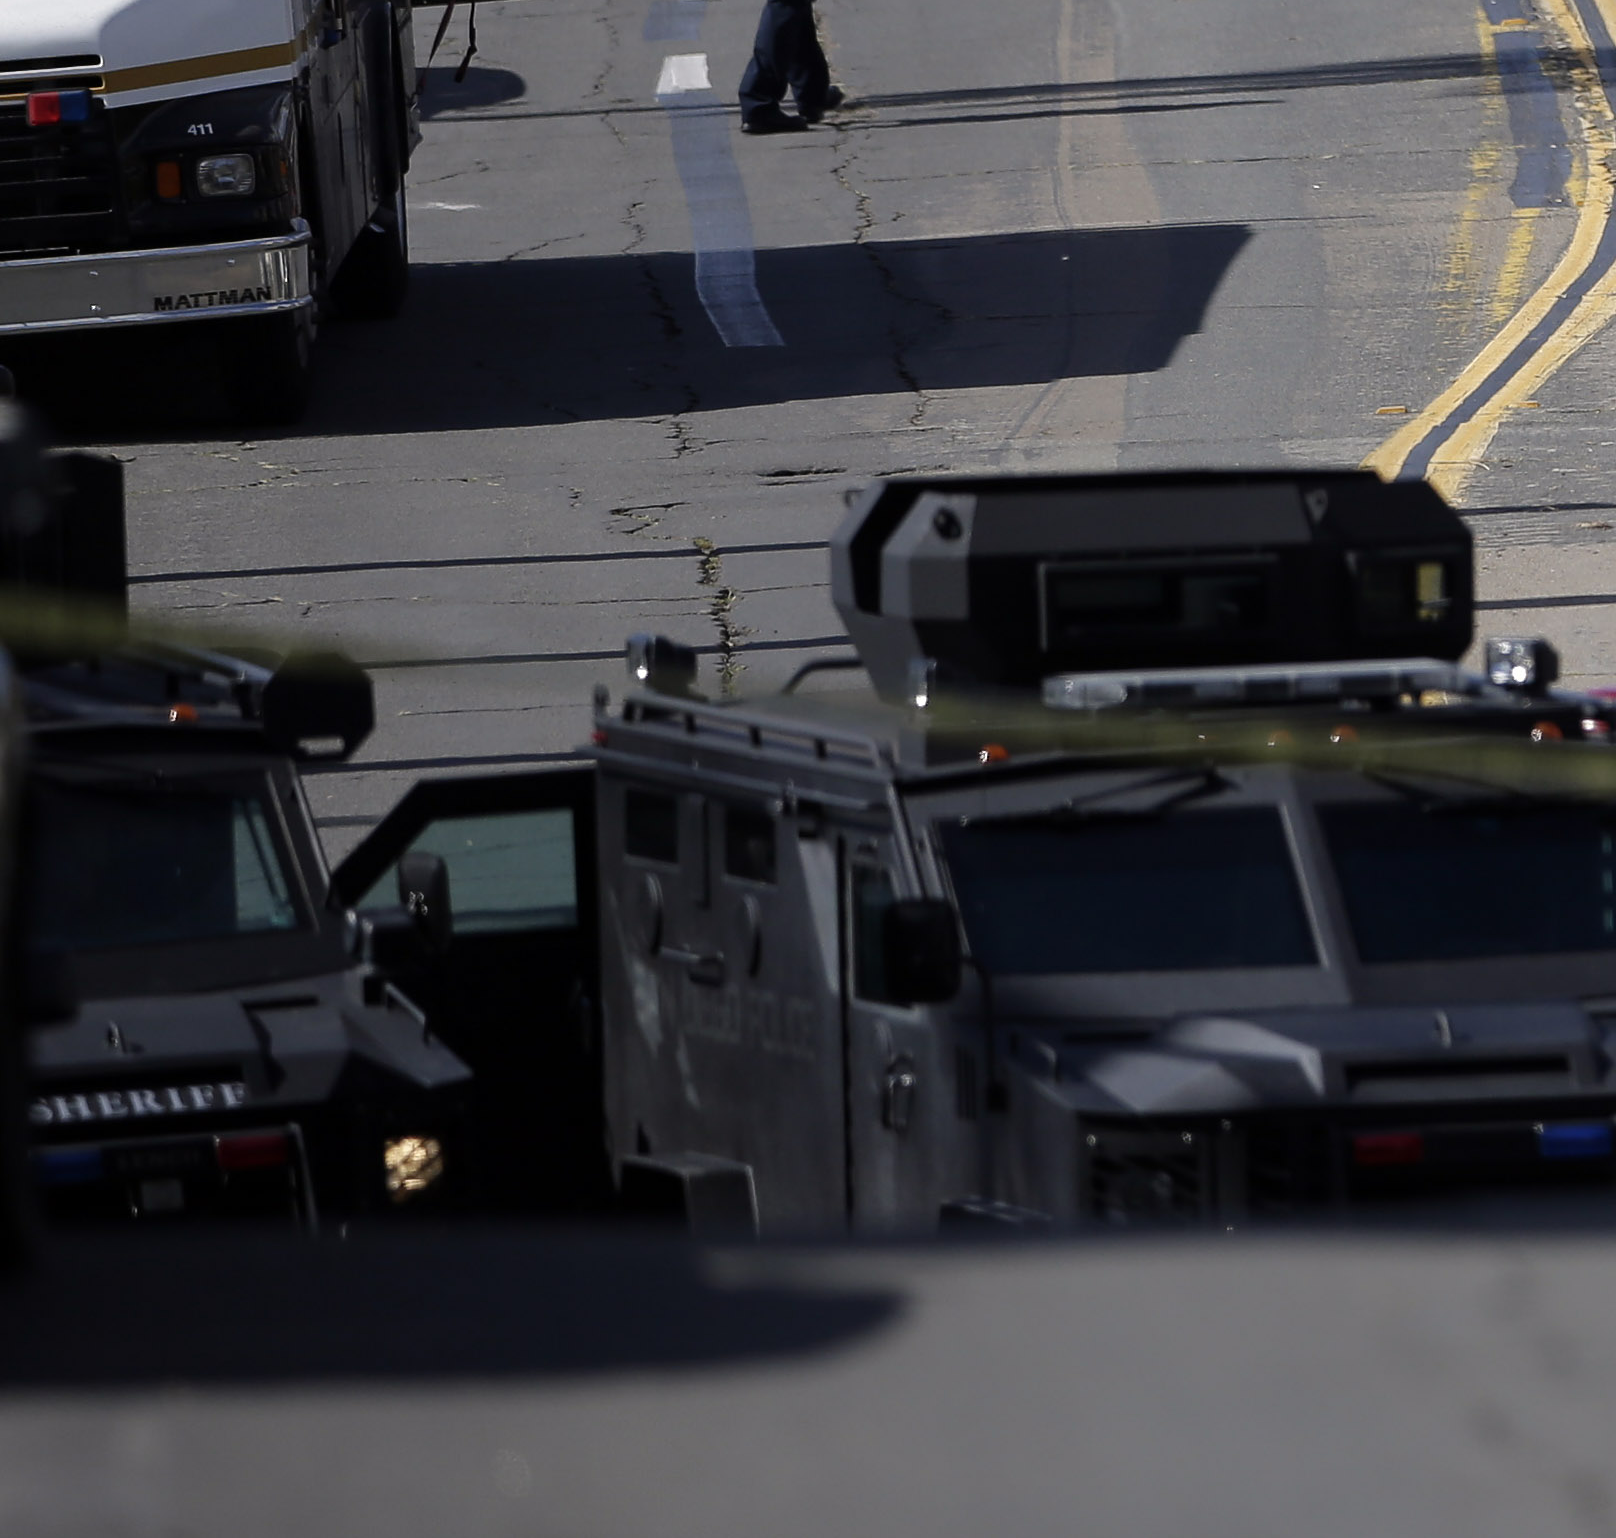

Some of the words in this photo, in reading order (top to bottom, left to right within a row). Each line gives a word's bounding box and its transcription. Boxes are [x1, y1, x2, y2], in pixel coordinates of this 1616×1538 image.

[188, 123, 214, 136] 411
[154, 287, 273, 312] MATTMAN
[28, 1080, 247, 1125] SHERIFF
